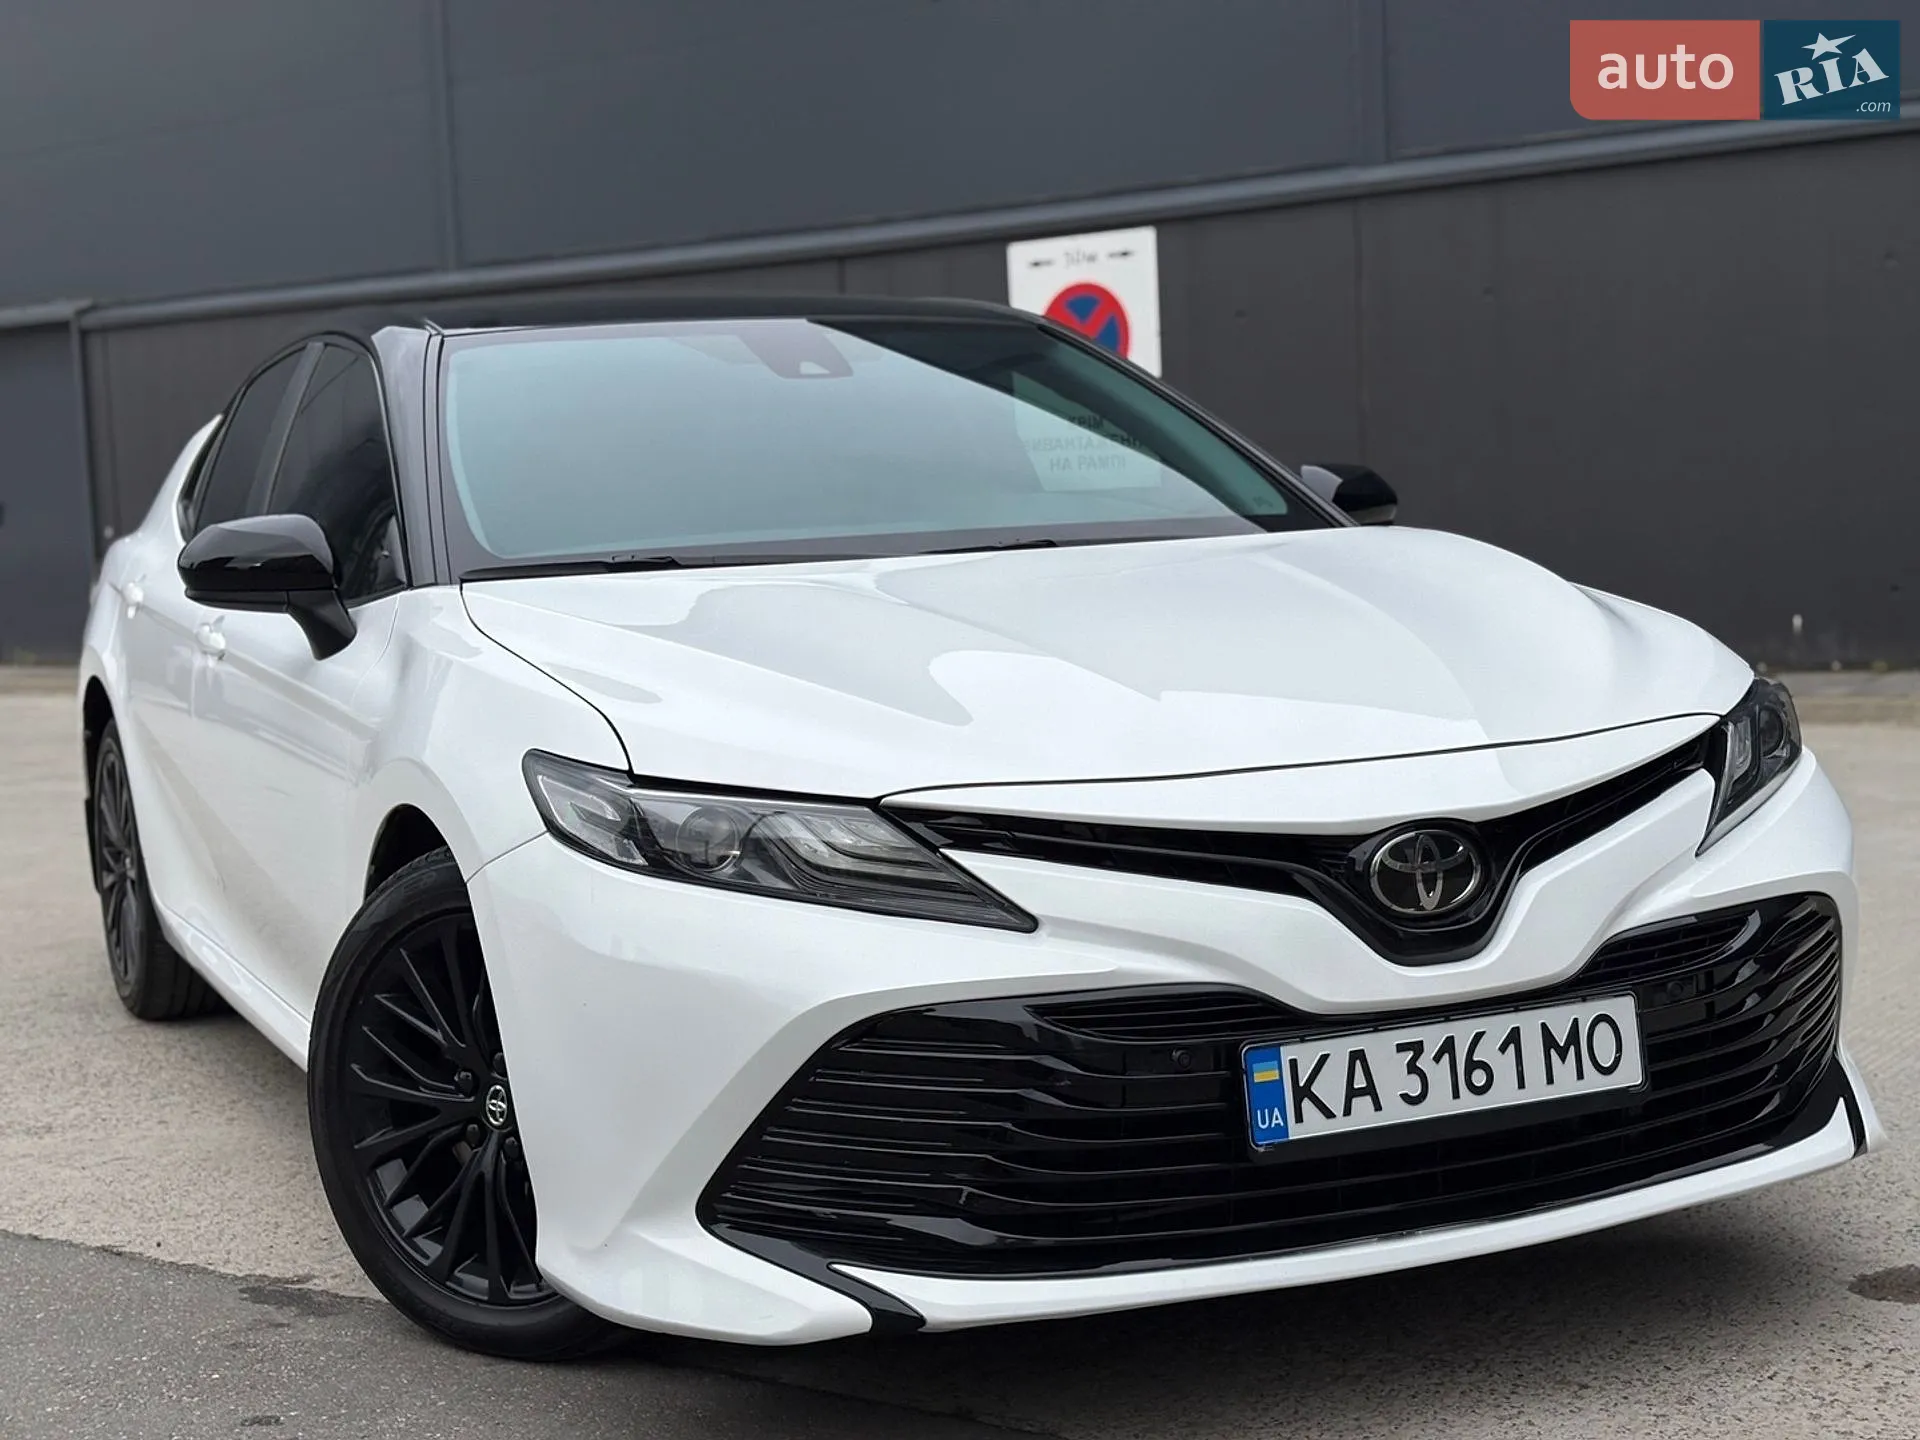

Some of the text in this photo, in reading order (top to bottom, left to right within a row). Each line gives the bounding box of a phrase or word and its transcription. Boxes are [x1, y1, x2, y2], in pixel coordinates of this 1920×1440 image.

[1288, 1012, 1623, 1124] KA 3161 MO
[1257, 1107, 1284, 1129] UA
